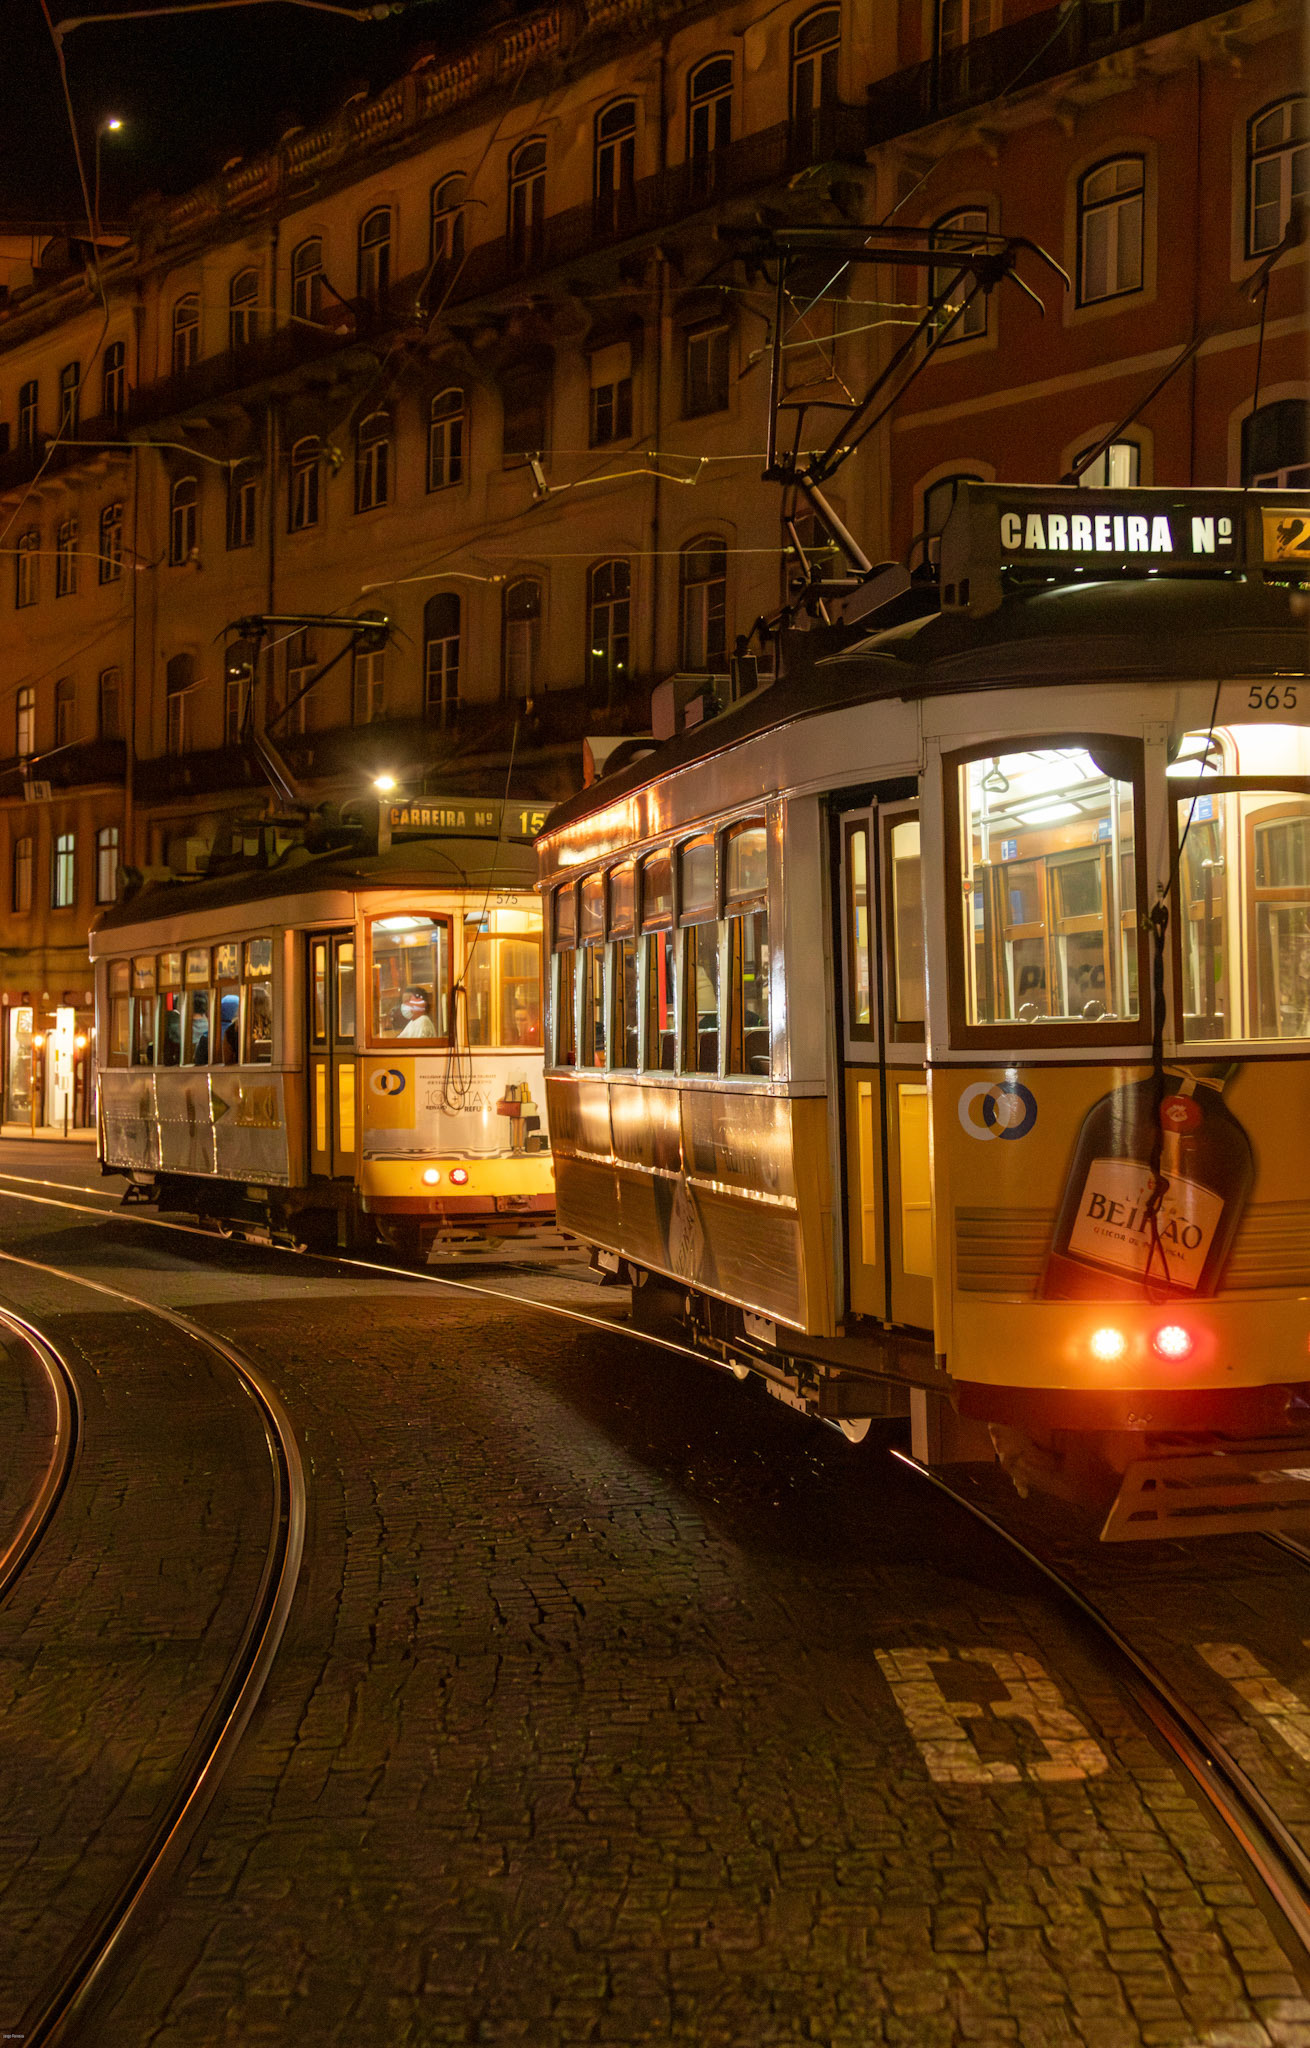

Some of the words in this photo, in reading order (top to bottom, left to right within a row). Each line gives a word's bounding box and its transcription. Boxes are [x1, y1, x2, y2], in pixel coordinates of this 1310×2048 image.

[1000, 512, 1173, 552] CARREIRA
[1191, 516, 1233, 554] Nº
[1247, 685, 1298, 710] 565
[390, 807, 466, 828] CARREIRA
[519, 810, 546, 835] 15
[496, 893, 518, 905] 575
[465, 1090, 492, 1106] TAX
[464, 1105, 493, 1113] REFUD
